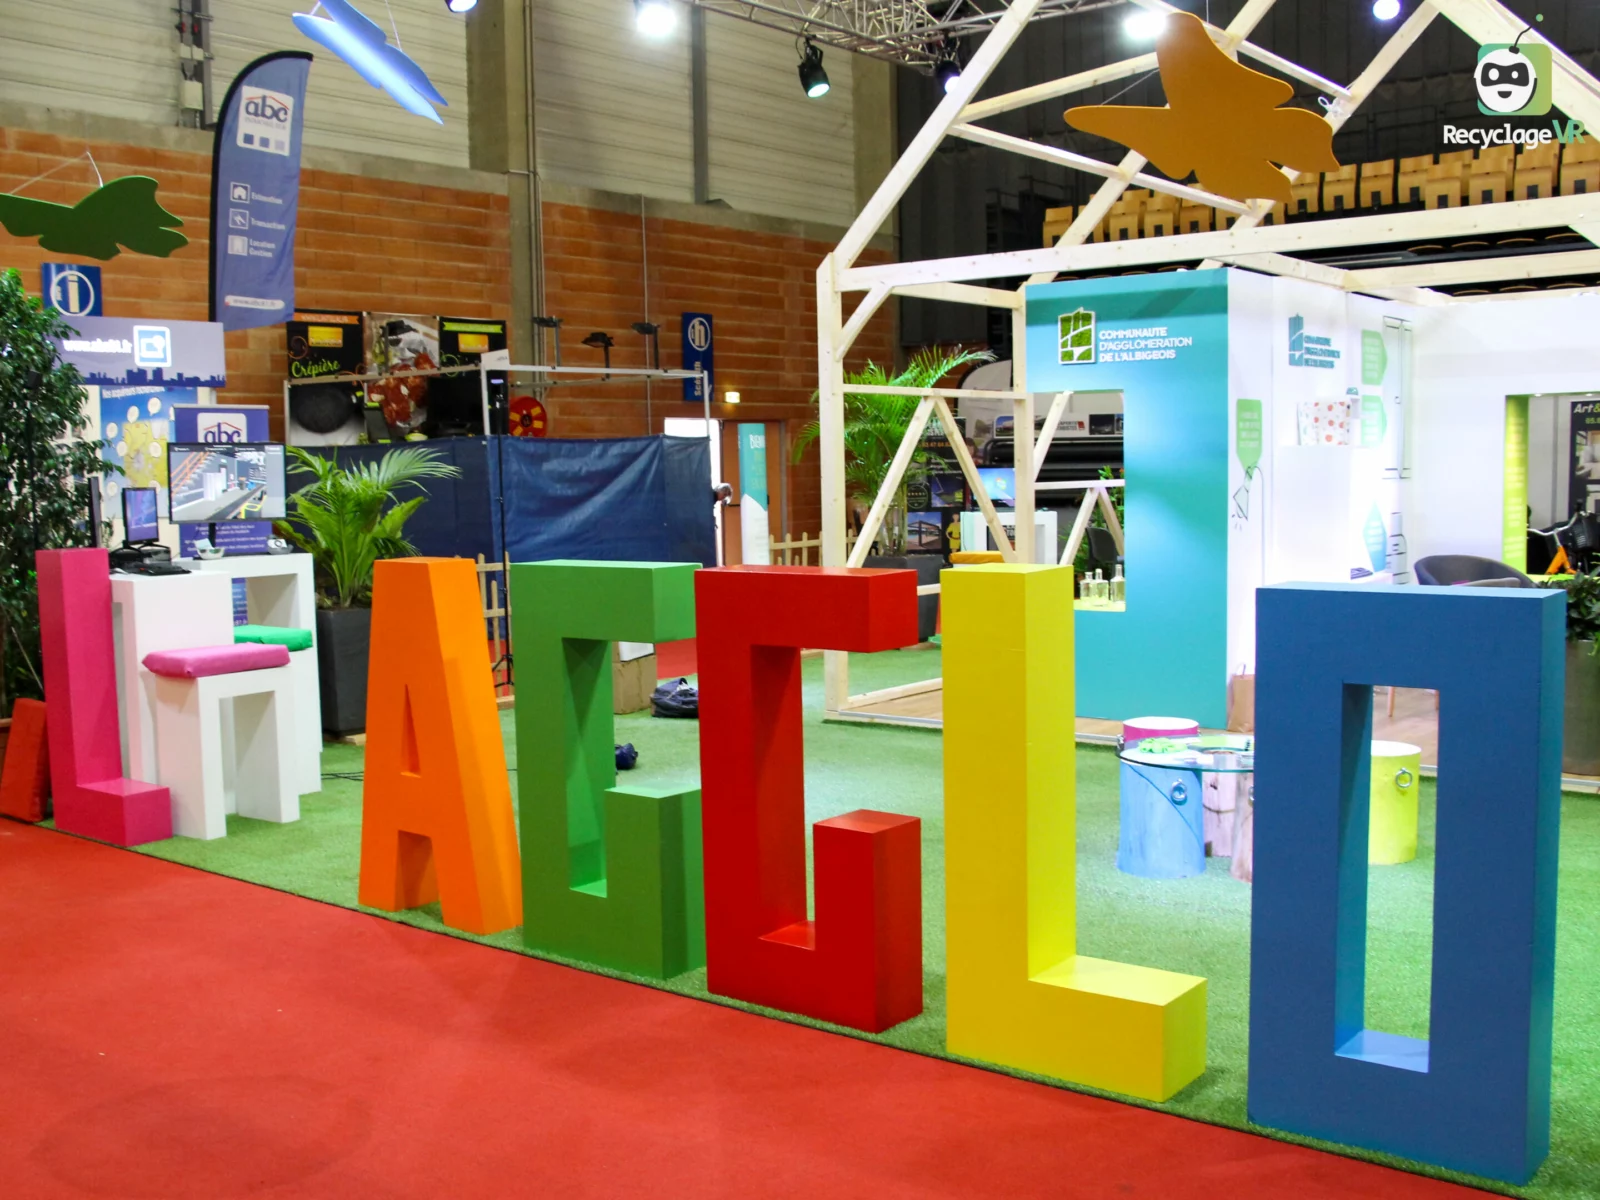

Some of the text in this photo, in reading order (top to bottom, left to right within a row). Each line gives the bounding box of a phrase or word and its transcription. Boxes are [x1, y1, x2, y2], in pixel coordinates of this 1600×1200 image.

[245, 94, 288, 123] abc
[1099, 327, 1168, 340] COMMUNAUTE
[1099, 337, 1193, 351] D'AGGLOMERATION
[1099, 349, 1177, 362] DE L'ALBIGEOIS
[291, 358, 340, 378] Crépière
